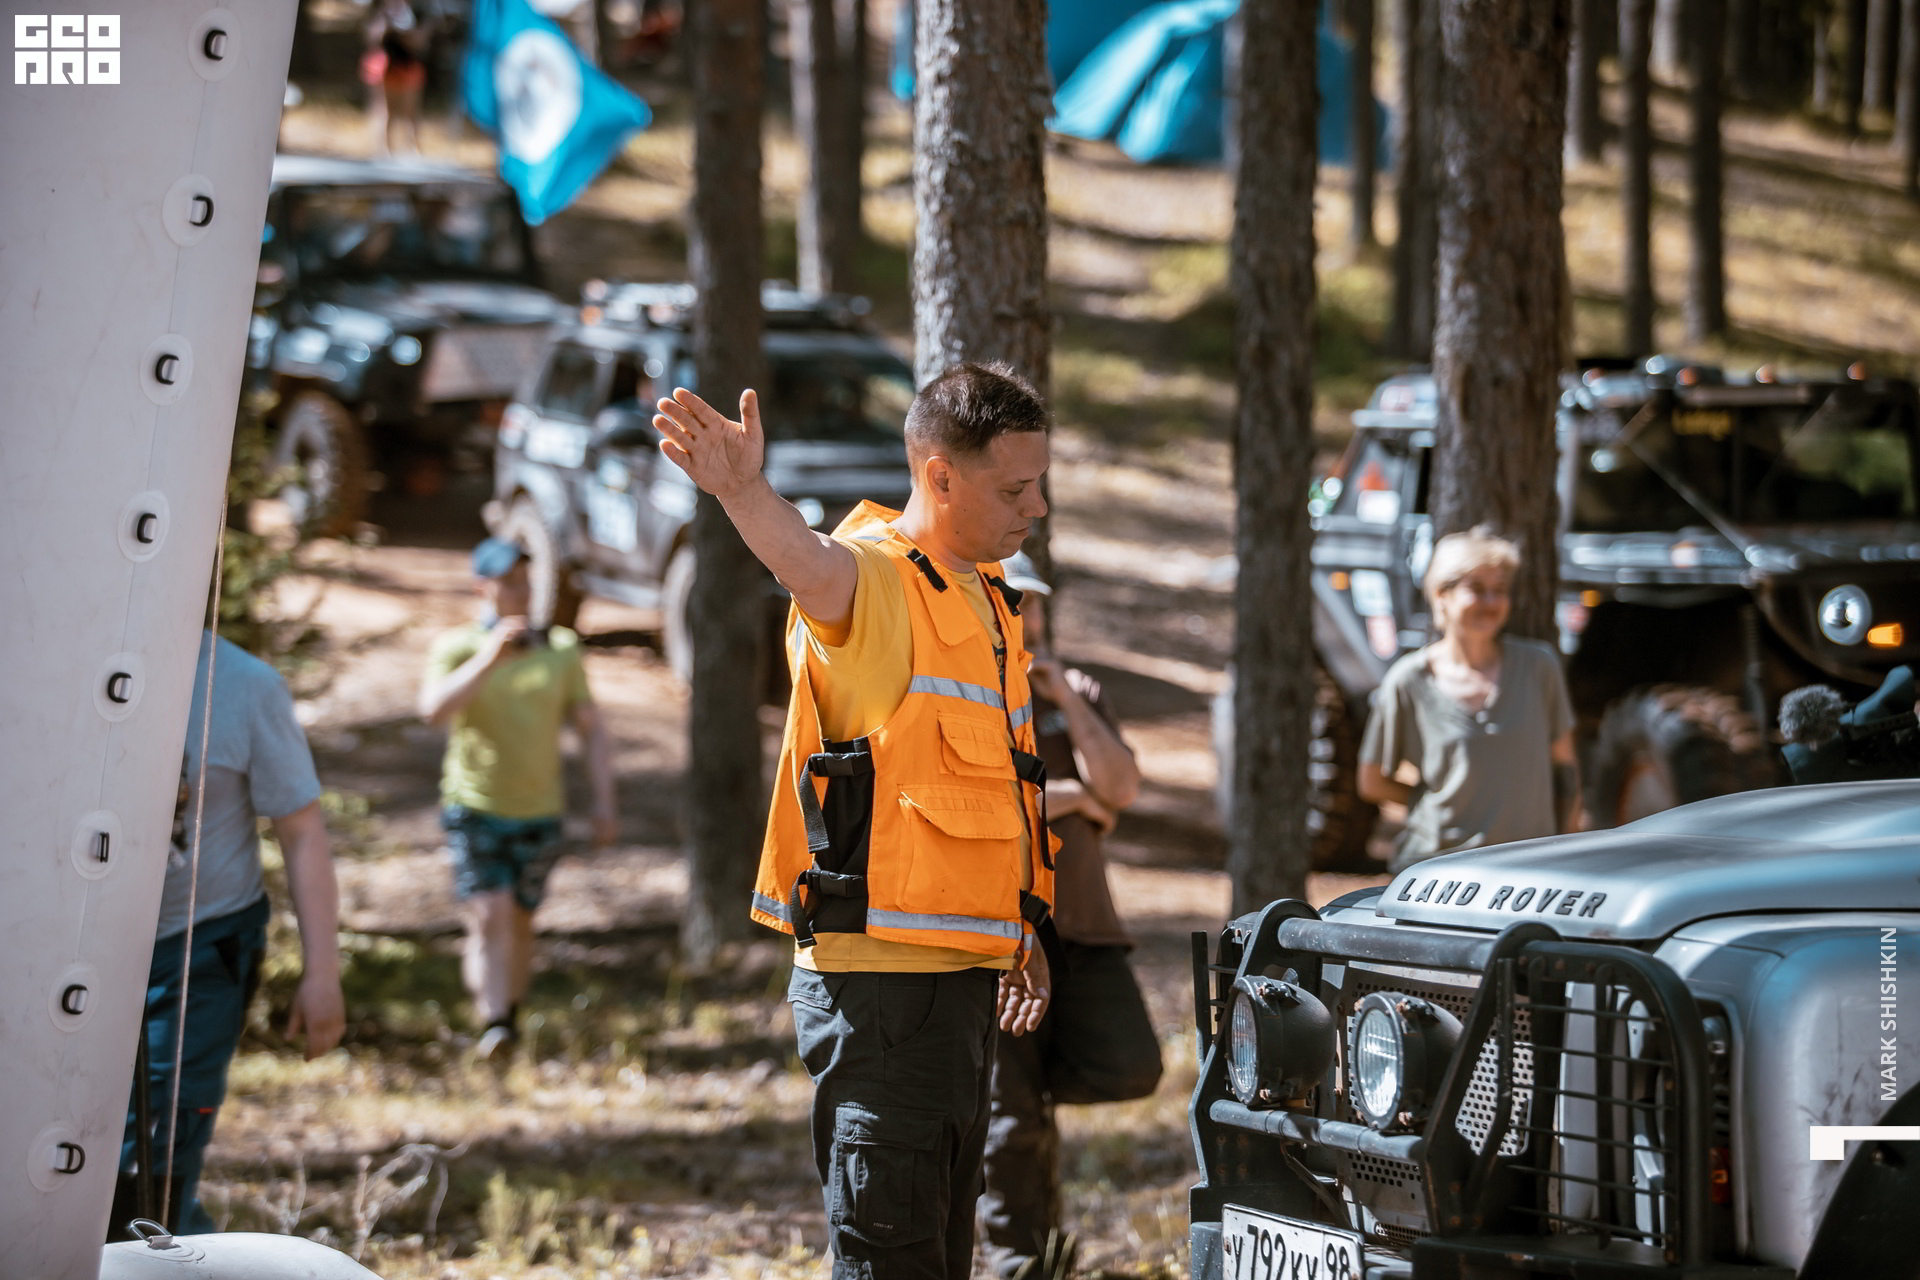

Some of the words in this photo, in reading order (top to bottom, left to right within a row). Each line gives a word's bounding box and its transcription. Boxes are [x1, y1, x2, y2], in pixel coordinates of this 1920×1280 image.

[1397, 877, 1481, 906] LAND
[1488, 885, 1607, 918] ROVER
[1326, 1243, 1350, 1280] 98
